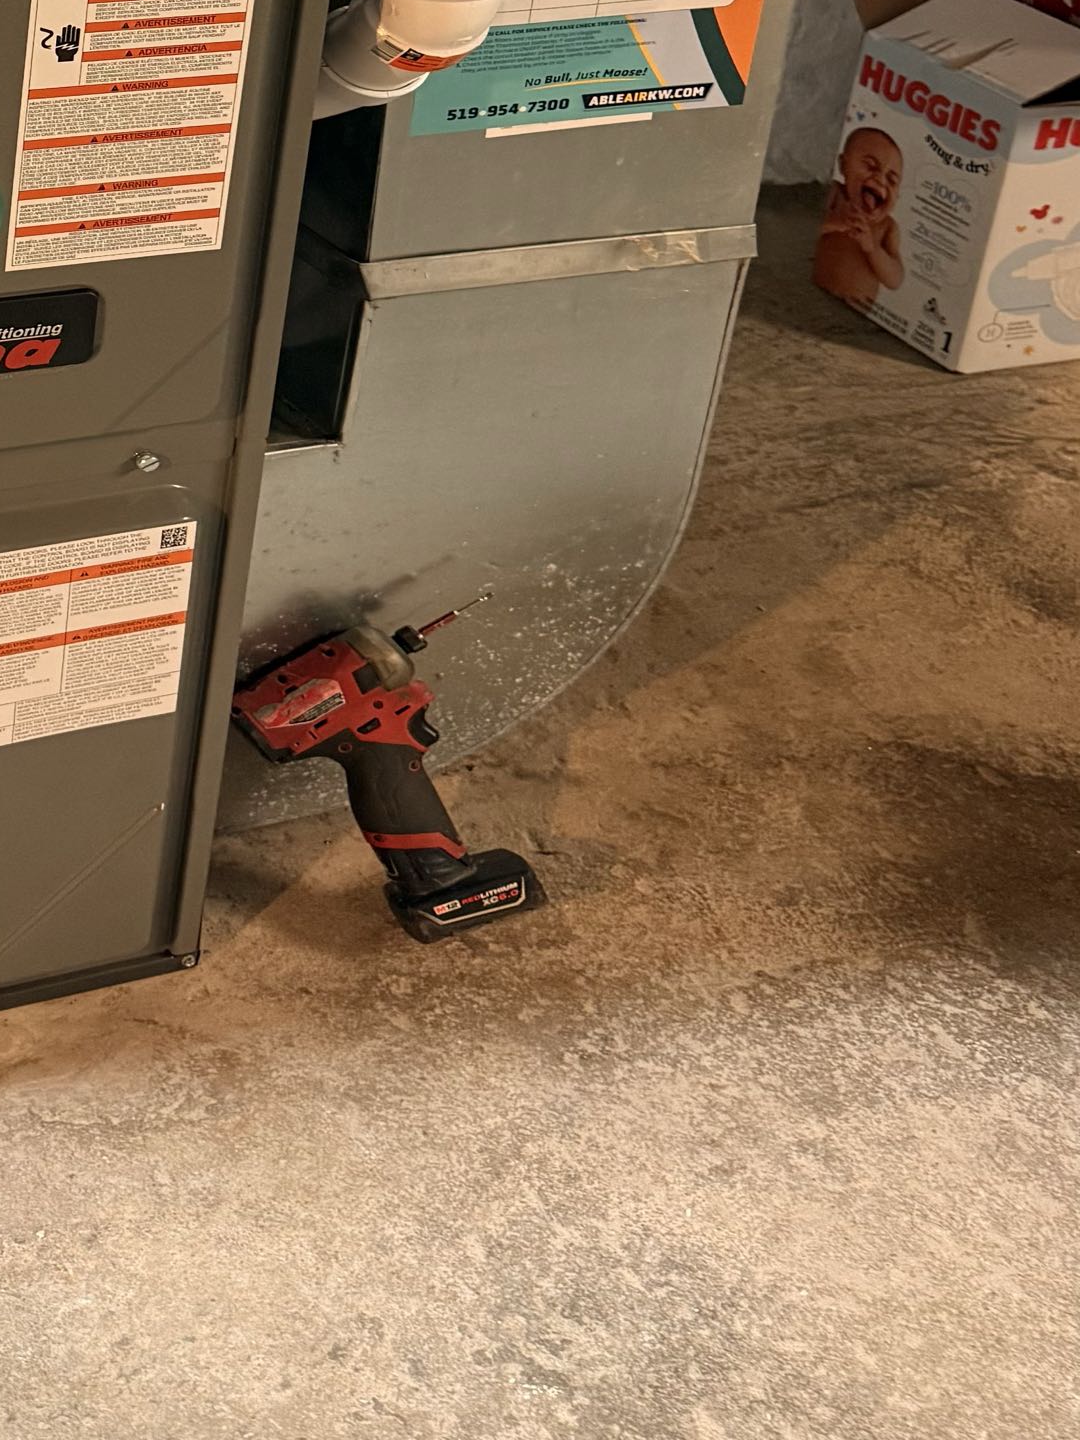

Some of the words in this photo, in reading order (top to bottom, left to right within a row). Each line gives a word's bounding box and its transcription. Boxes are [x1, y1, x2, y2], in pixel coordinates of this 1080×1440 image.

[134, 16, 216, 28] AVERTISSEMENT
[138, 44, 208, 56] ADVERTENCIA
[524, 77, 541, 88] No
[544, 72, 572, 85] Bull,
[576, 70, 602, 81] Just
[602, 68, 648, 78] Moose!
[122, 80, 168, 91] WARNING
[588, 86, 706, 107] ABLEAIRKW.COM
[858, 55, 1002, 152] HUGGIES
[102, 129, 184, 142] AVERTISSEMENT
[925, 134, 953, 165] snug
[953, 156, 964, 170] &
[965, 161, 990, 176] dry
[112, 180, 158, 190] WARNING
[93, 214, 173, 227] AVERTISSEMENT
[461, 882, 518, 904] REDLITHIUM
